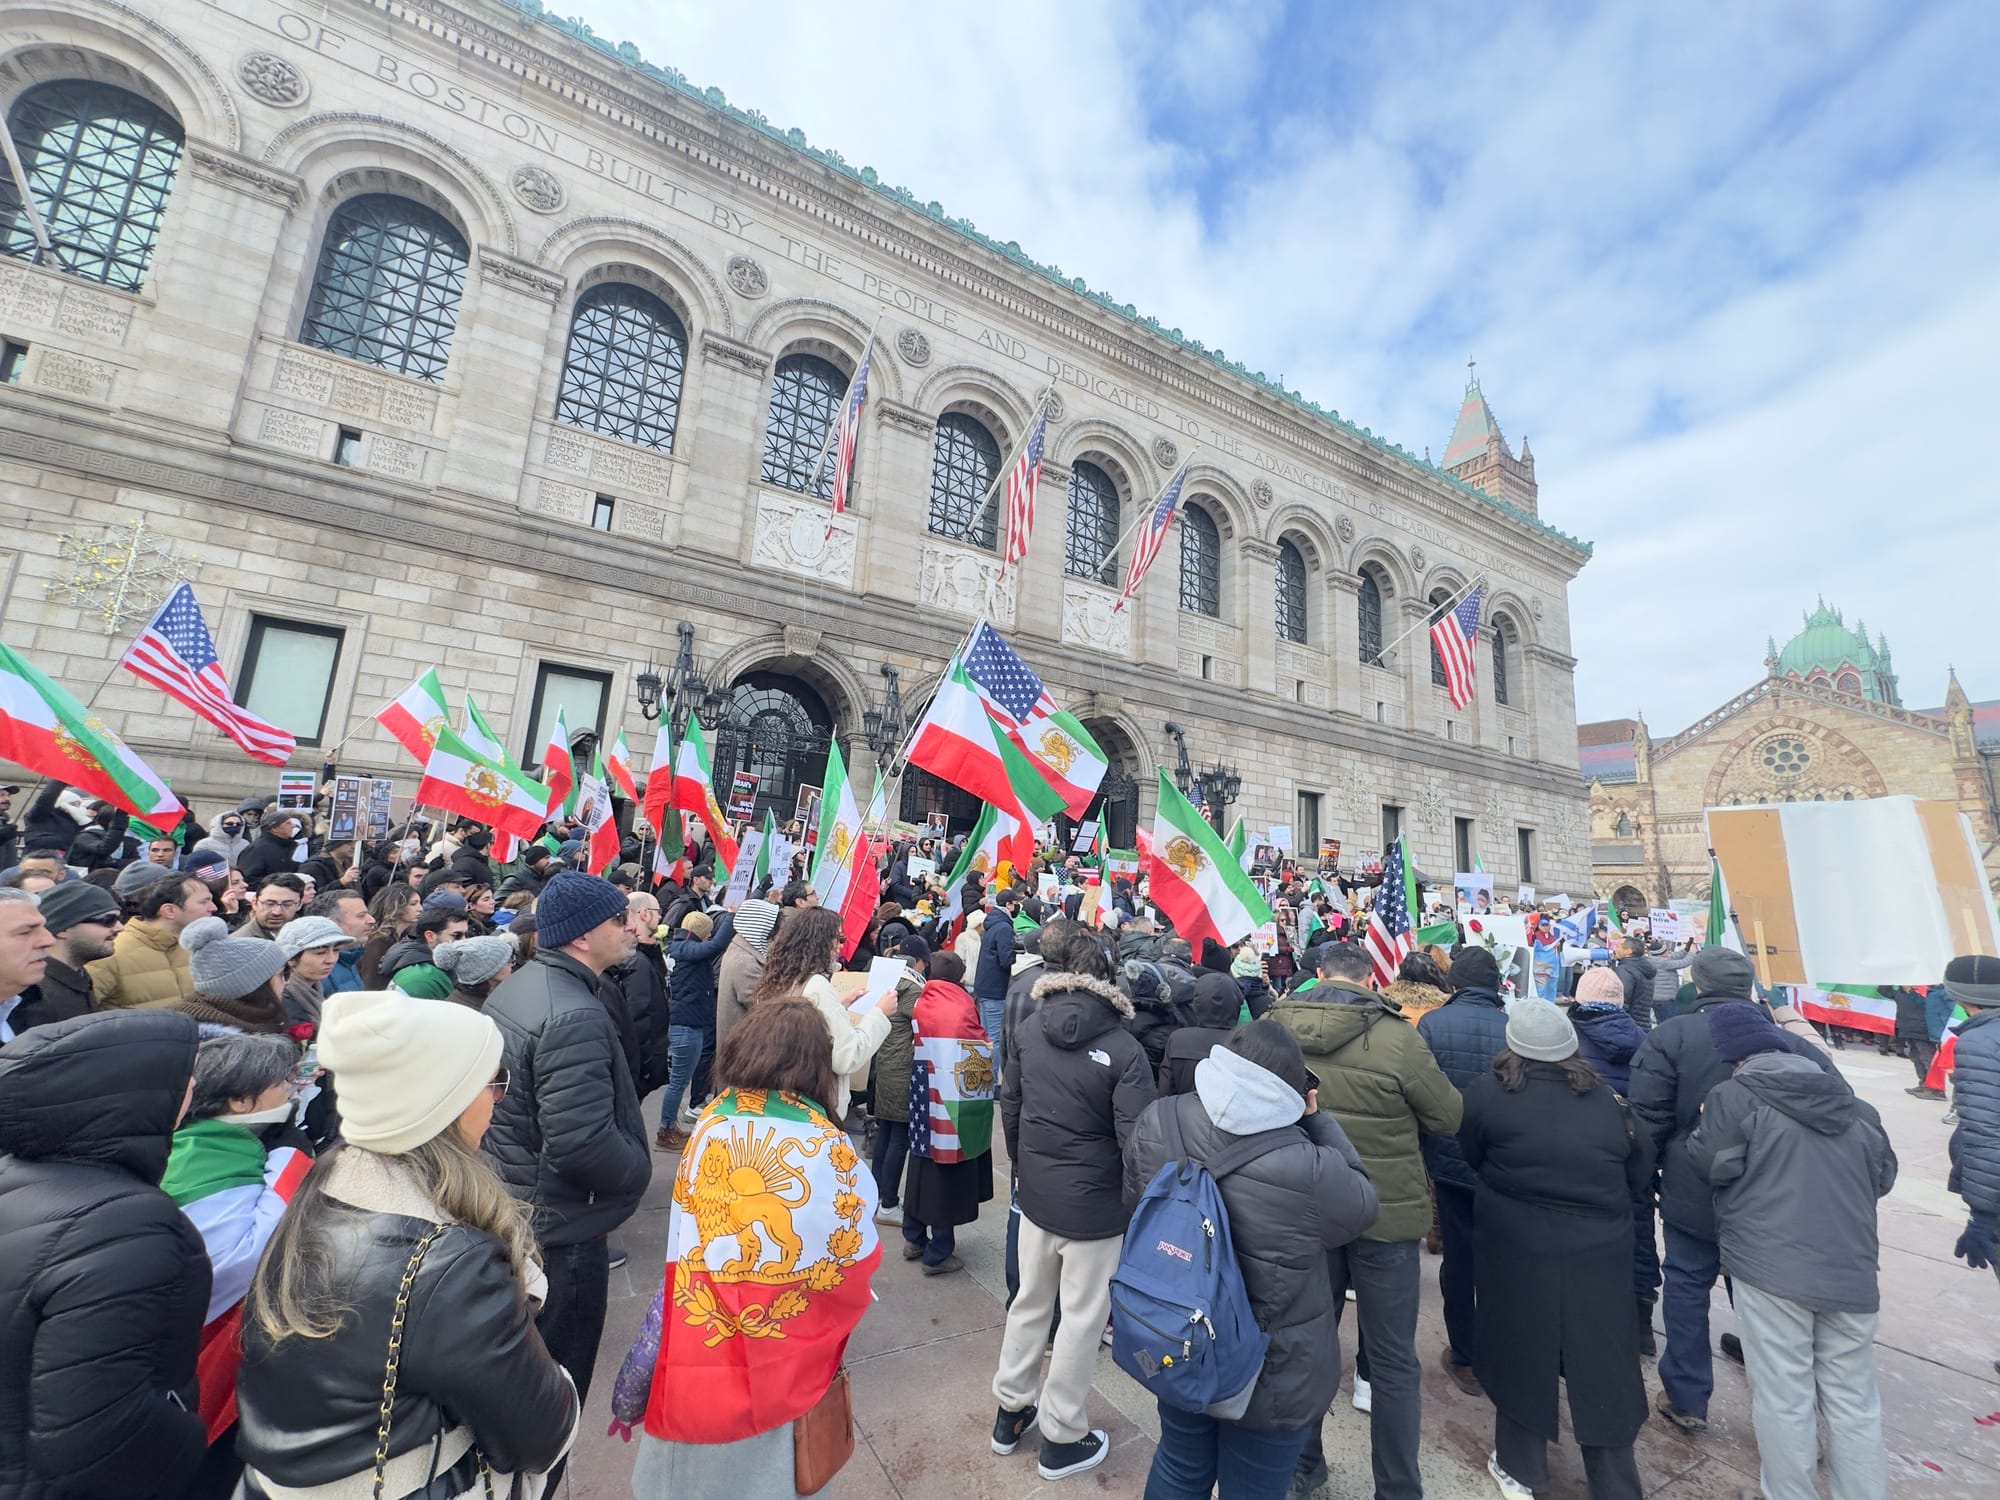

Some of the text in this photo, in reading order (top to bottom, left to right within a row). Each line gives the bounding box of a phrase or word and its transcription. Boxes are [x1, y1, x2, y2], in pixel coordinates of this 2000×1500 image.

[278, 14, 346, 50] OF
[375, 55, 558, 153] BOSTON
[585, 148, 687, 206] BUILT
[711, 205, 754, 235] BY
[780, 235, 842, 280] THE
[862, 273, 958, 331] PEOPLE
[978, 329, 1026, 360] AND
[1046, 356, 1160, 419] DEDICATED
[1175, 414, 1200, 436] TO
[1211, 430, 1243, 457] THE
[1254, 452, 1360, 507] ADVANCEMENT
[1369, 502, 1386, 518] OF
[1395, 512, 1451, 549] LEARNING
[58, 323, 84, 336] FOX
[60, 313, 120, 336] CHATHAM
[285, 350, 333, 369] GALILEO
[270, 409, 307, 425] GALEN
[746, 843, 756, 856] NO
[735, 870, 749, 881] WITH
